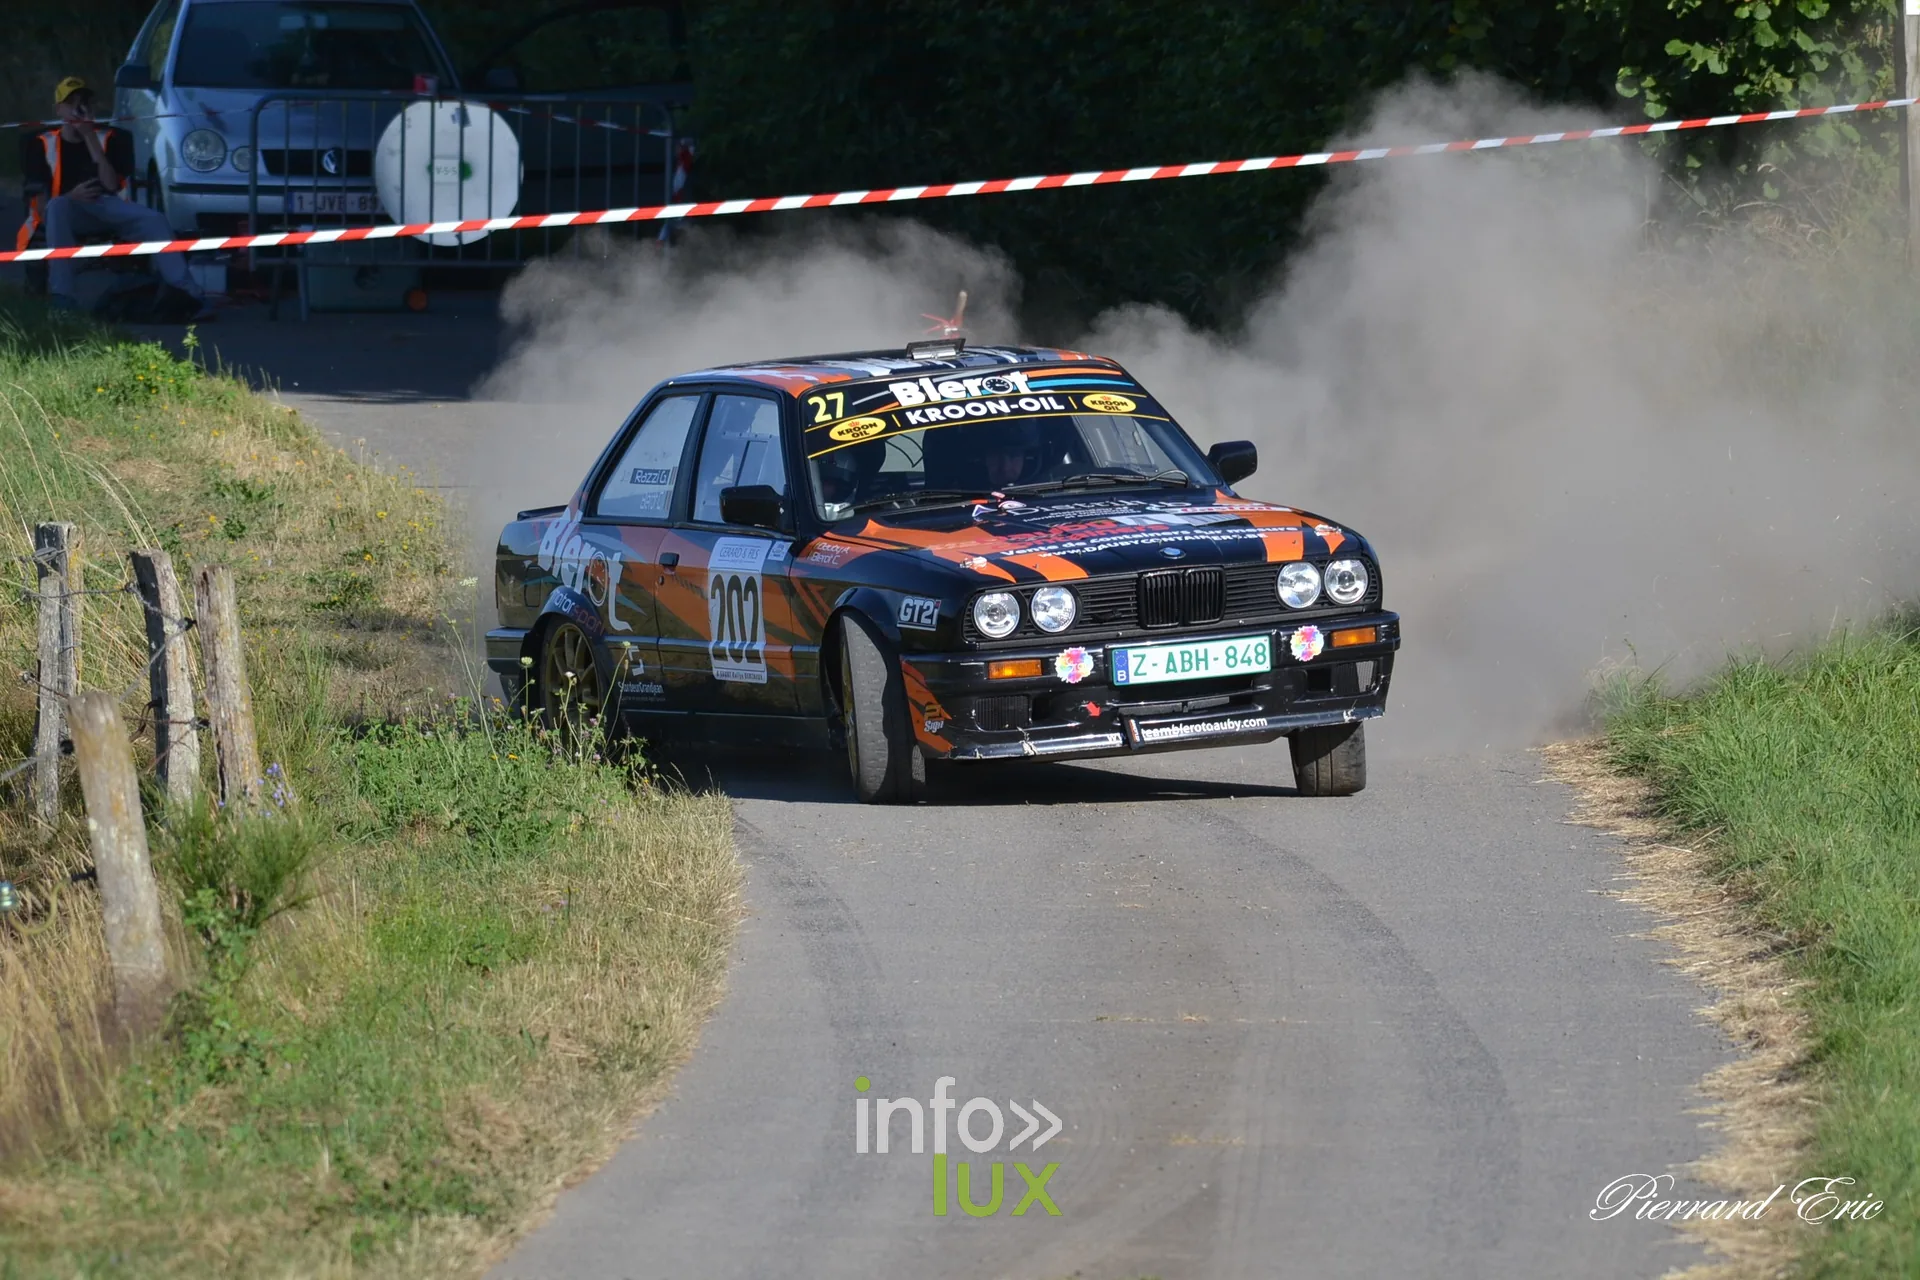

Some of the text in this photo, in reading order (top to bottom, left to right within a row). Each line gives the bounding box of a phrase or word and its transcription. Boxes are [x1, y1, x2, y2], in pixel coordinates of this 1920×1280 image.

[808, 392, 845, 424] 27
[905, 396, 1065, 427] KROON-OIL
[1087, 398, 1134, 410] KROON
[1103, 404, 1124, 413] OIL
[837, 421, 879, 438] KROON
[850, 429, 870, 440] OIL
[1000, 525, 1299, 556] Vente de containers sur mesure
[711, 573, 763, 664] 202
[900, 597, 941, 625] GT2i
[1132, 642, 1268, 677] Z-ABH-848
[1117, 671, 1128, 682] B
